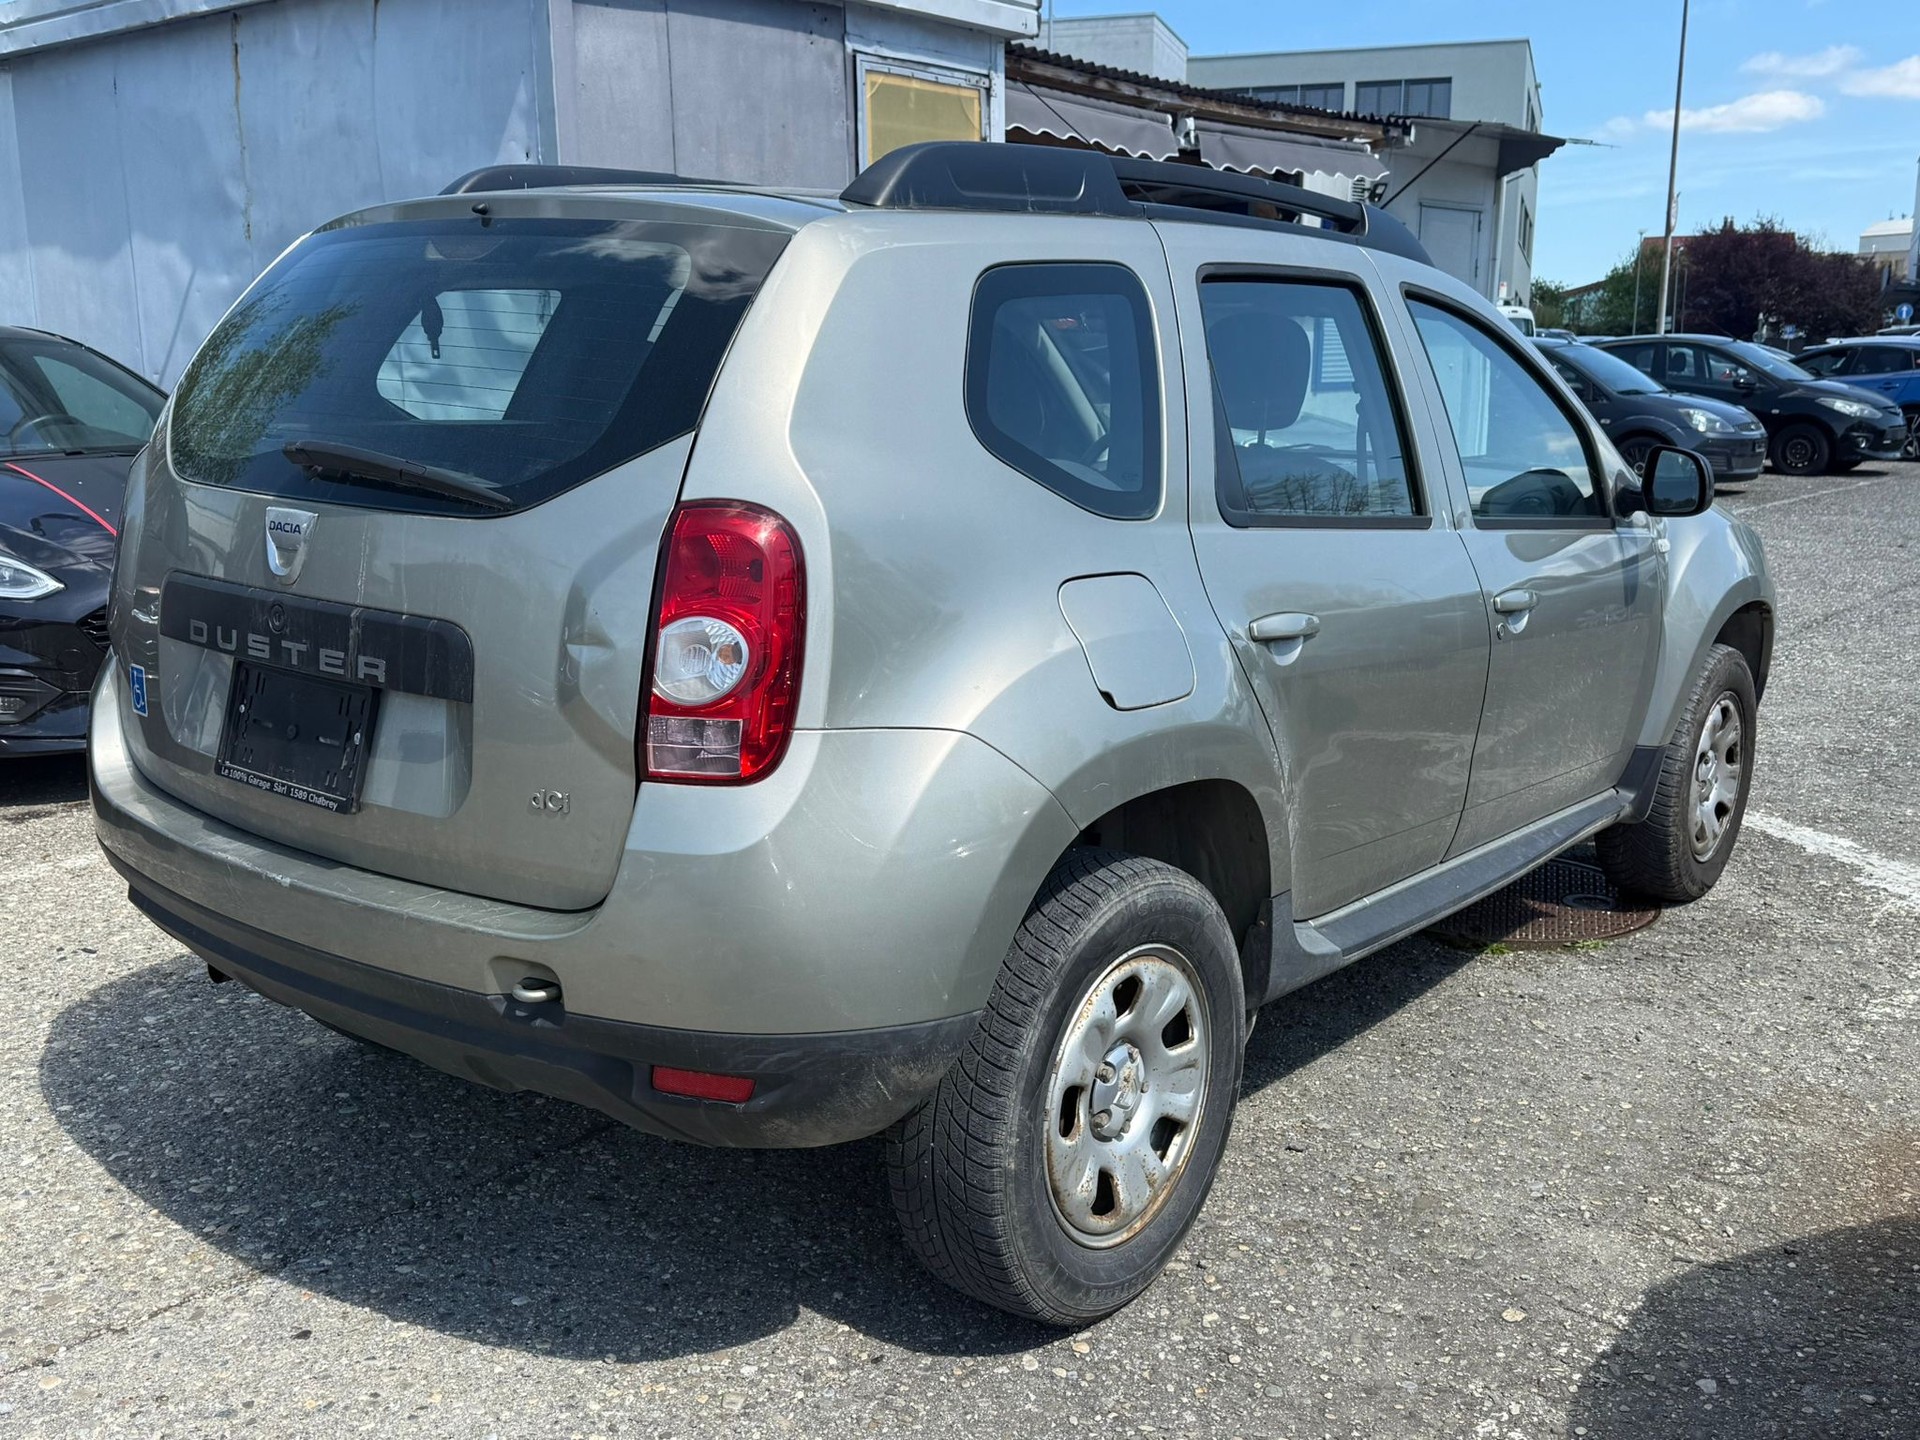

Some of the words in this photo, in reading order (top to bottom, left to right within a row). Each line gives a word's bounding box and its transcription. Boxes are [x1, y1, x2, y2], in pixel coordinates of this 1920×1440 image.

[269, 520, 302, 535] DACIA
[189, 618, 386, 683] DUSTER
[221, 766, 229, 776] Le
[229, 769, 247, 782] 100%
[248, 775, 271, 790] Garage
[290, 788, 307, 800] 1589
[308, 793, 338, 811] Chabrey
[530, 789, 570, 814] dCi
